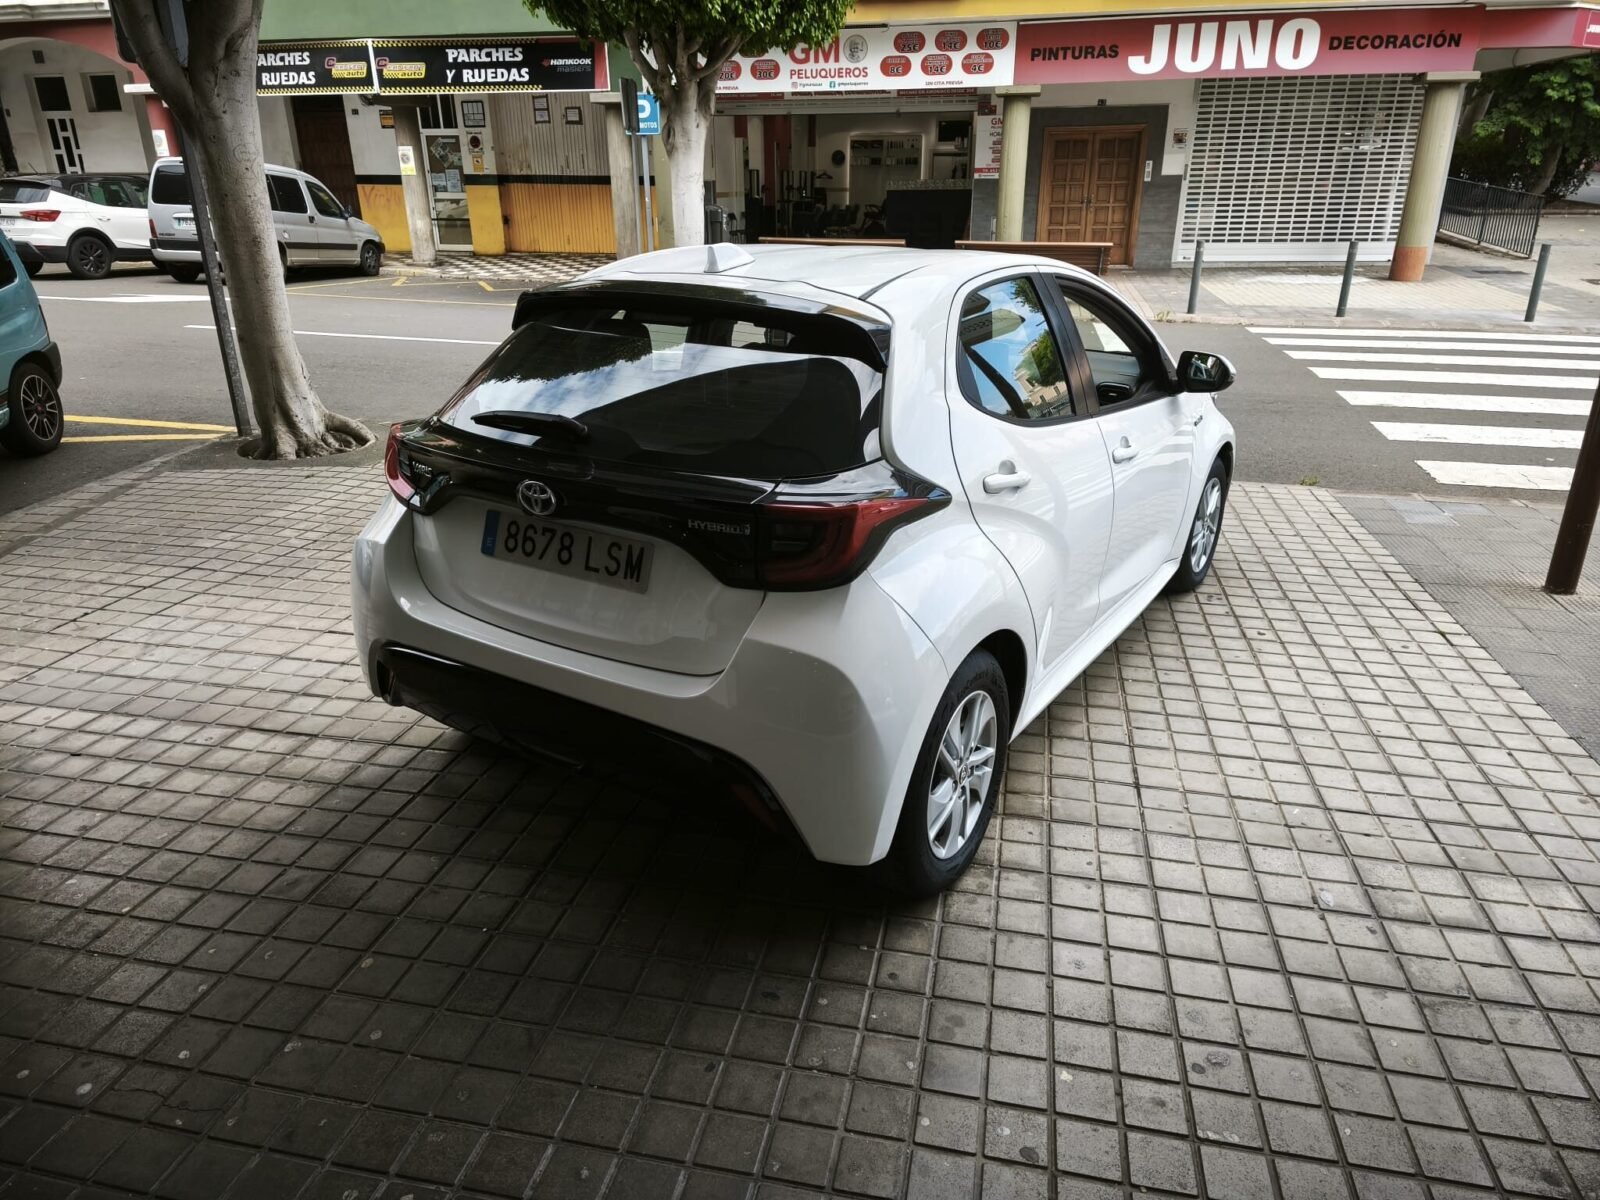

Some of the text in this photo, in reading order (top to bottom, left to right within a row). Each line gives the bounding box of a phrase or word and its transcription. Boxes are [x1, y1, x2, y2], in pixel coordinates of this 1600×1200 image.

[1127, 18, 1321, 75] JUNO
[1328, 30, 1462, 51] DECORACIÓN
[256, 51, 311, 66] ARCHES
[445, 47, 523, 62] PARCHES
[789, 36, 840, 65] GM
[1030, 44, 1119, 62] PINTURAS
[261, 71, 316, 86] RUEDAS
[445, 68, 529, 83] Y RUEDAS
[790, 66, 869, 80] PELUQUEROS
[504, 520, 645, 583] 8678 LSM
